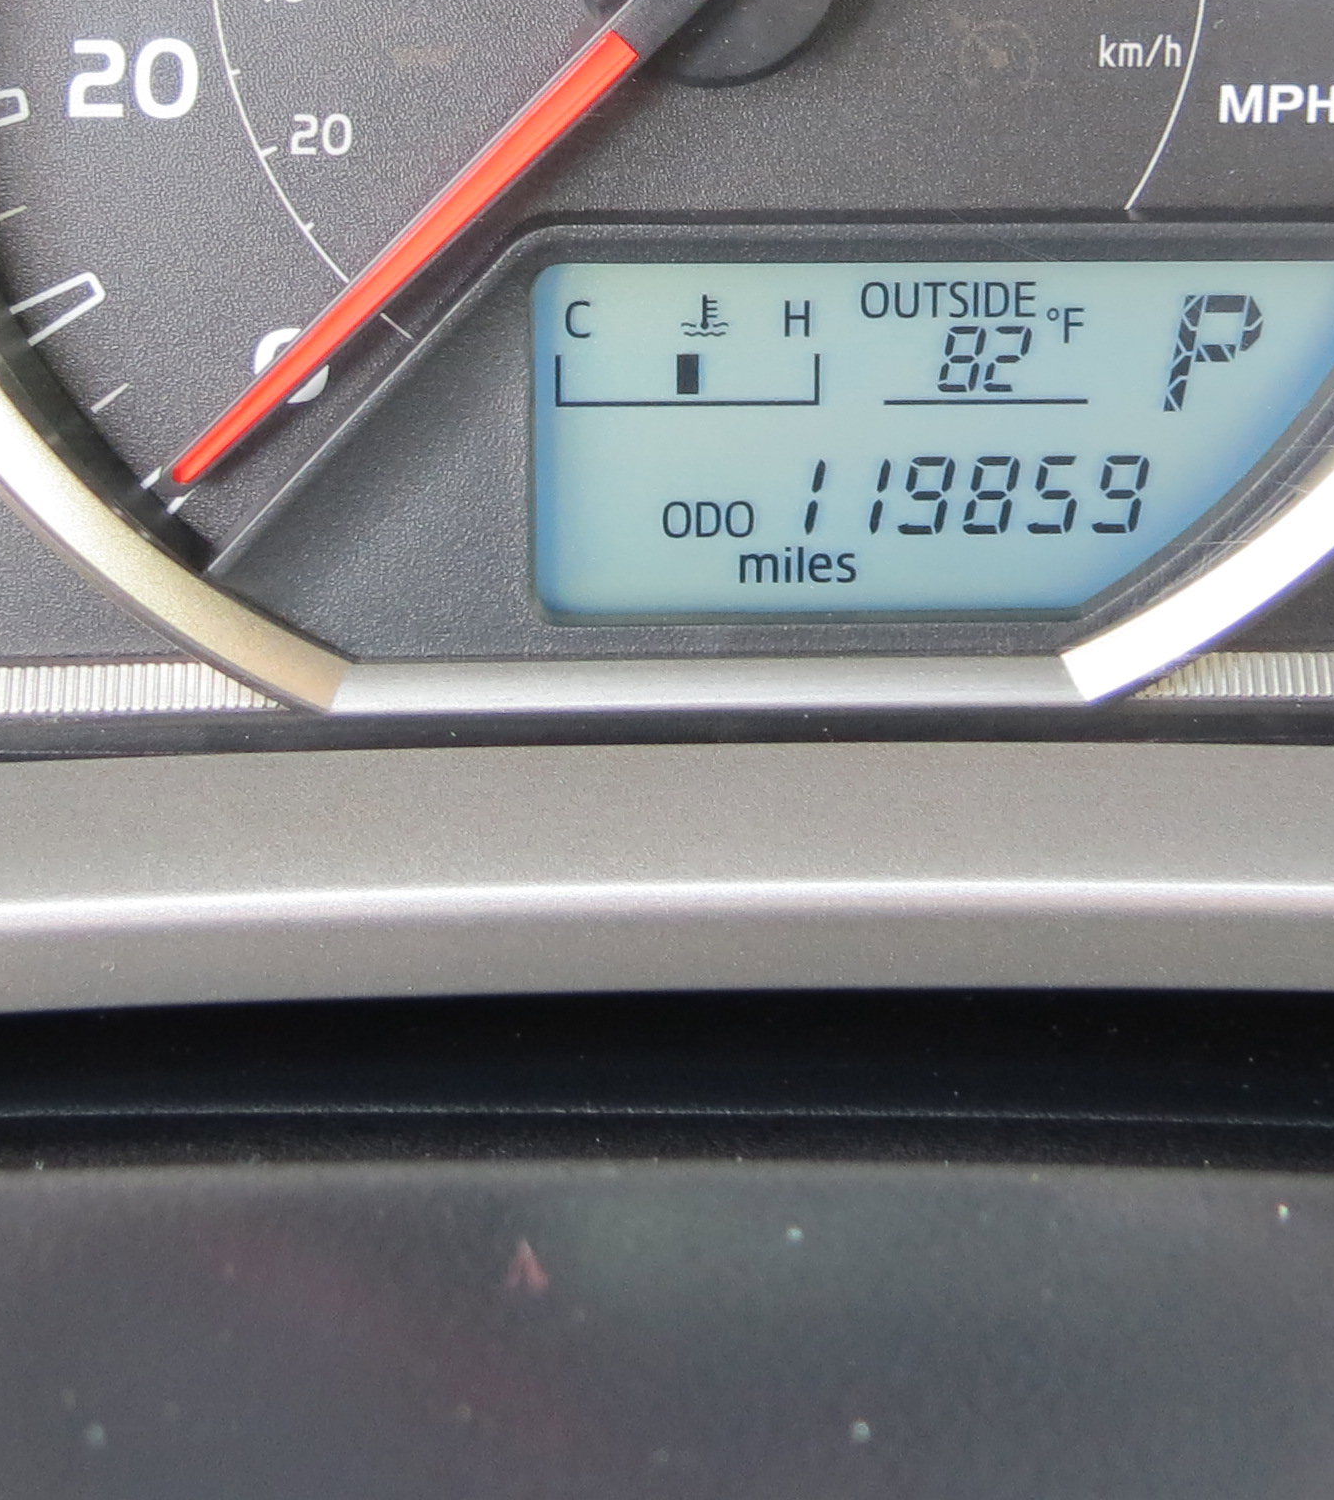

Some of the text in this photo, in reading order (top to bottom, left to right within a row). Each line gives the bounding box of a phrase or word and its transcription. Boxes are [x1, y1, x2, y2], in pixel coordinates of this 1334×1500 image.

[1098, 33, 1182, 68] km/h
[68, 37, 200, 120] 20
[289, 112, 353, 156] 20
[564, 299, 591, 339] C
[784, 299, 811, 338] H
[860, 280, 1037, 319] OUTSIDE
[937, 325, 1033, 393] 82
[1163, 294, 1264, 412] P
[662, 454, 1150, 539] ODO 119859
[739, 546, 857, 584] miles
